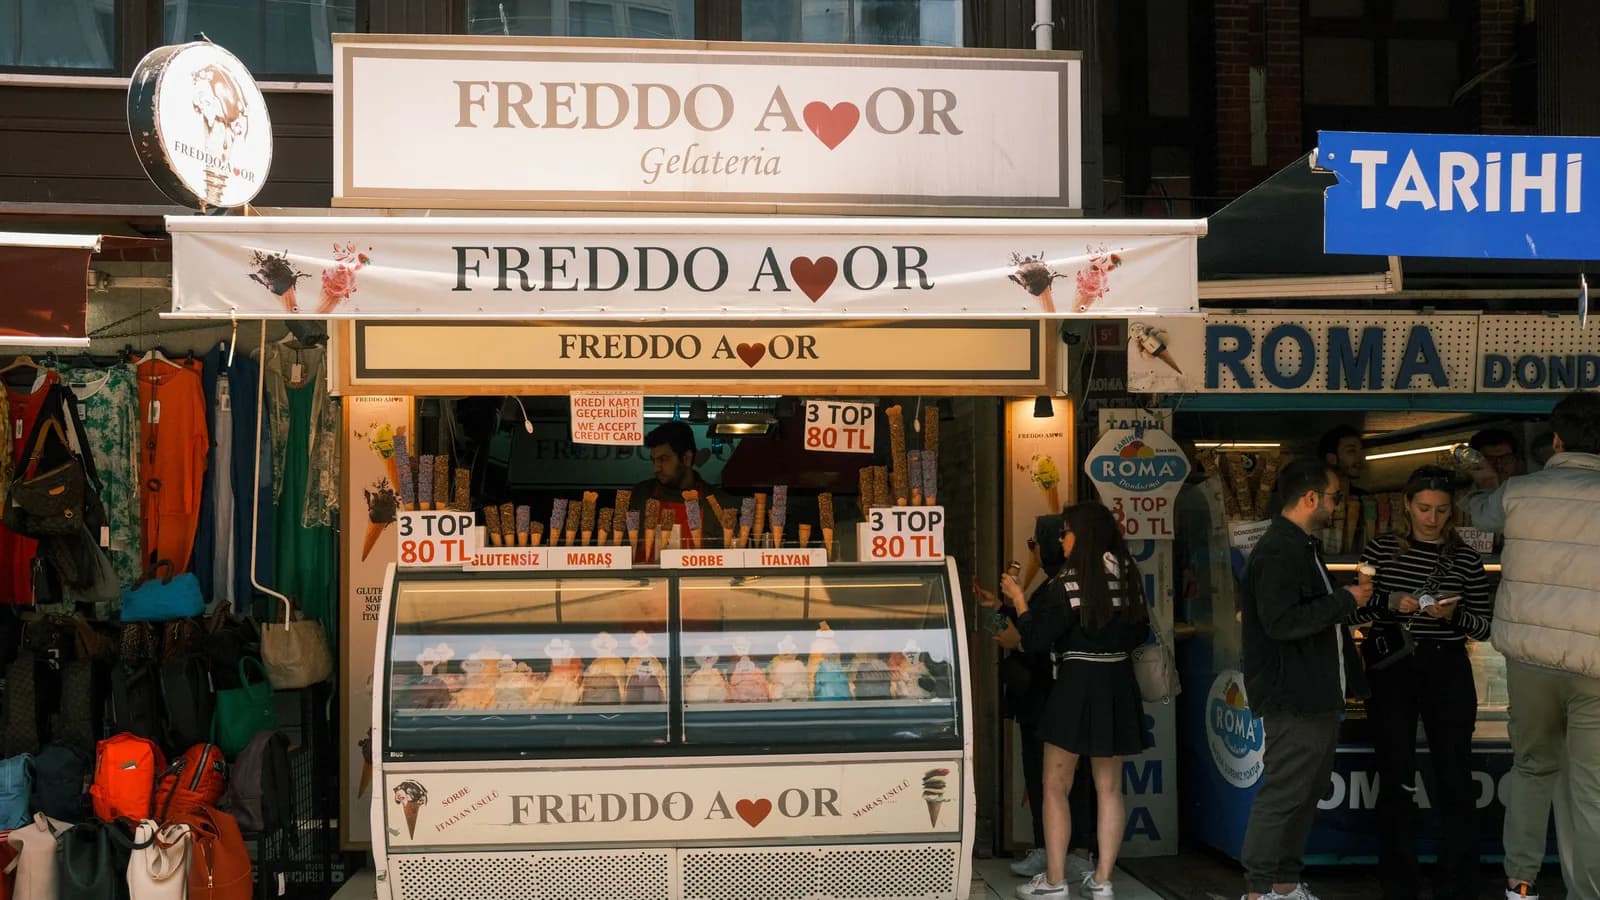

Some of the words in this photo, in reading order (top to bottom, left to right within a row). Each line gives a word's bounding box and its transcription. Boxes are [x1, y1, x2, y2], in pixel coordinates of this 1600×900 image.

[453, 81, 734, 131] FREDDO
[174, 141, 222, 168] FREDDO
[641, 143, 781, 185] Gelateria
[1350, 149, 1584, 214] TARİHİ
[452, 247, 728, 292] FREDDO
[559, 335, 701, 359] FREDDO
[1205, 325, 1449, 390] ROMA
[574, 396, 606, 407] KREDİ
[609, 397, 640, 407] KARTI
[806, 403, 819, 422] 3
[828, 405, 873, 425] TOP
[574, 432, 610, 441] CREDIT
[613, 432, 642, 441] CARD
[578, 422, 594, 431] WE
[597, 422, 637, 431] ACCEPT
[806, 426, 838, 449] 80
[846, 428, 872, 450] TL
[1102, 461, 1175, 477] ROMA
[1112, 497, 1124, 512] 3
[1130, 497, 1168, 512] TOP
[399, 515, 413, 536] 3
[421, 515, 473, 536] TOP
[872, 511, 884, 532] 3
[893, 511, 942, 532] TOP
[1147, 518, 1172, 535] TL
[401, 539, 434, 564] 80
[440, 539, 472, 562] TL
[871, 536, 904, 558] 80
[911, 535, 941, 558] TL
[567, 552, 612, 568] MARAŞ
[681, 555, 724, 567] SORBE
[761, 551, 811, 567] İTALYAN
[1215, 706, 1256, 743] ROMA
[441, 786, 471, 807] SORBE
[508, 792, 693, 825] FREDDO
